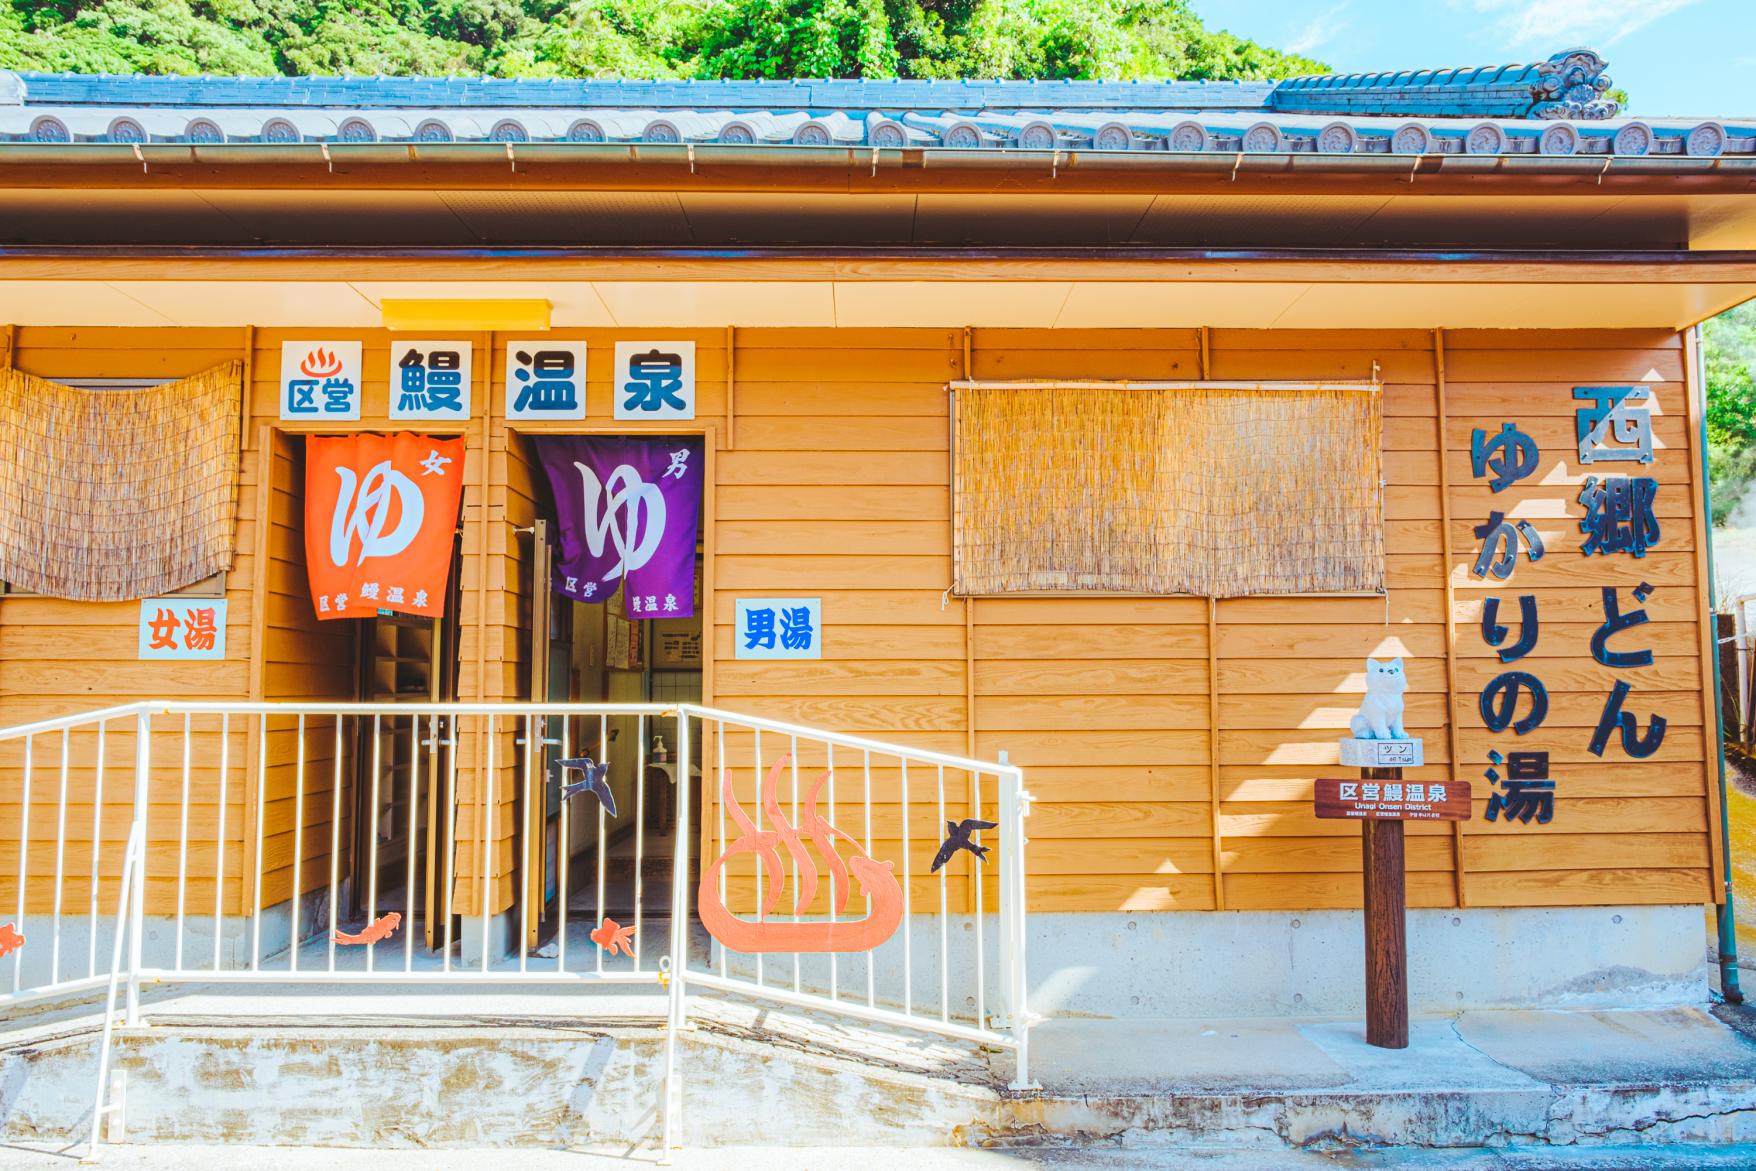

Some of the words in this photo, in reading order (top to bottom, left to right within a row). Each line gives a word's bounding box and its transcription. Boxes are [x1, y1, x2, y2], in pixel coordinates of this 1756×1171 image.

[420, 450, 452, 476] 女
[663, 448, 690, 479] 男
[330, 460, 425, 567] ゆ
[572, 461, 667, 583] ゆ
[1572, 386, 1667, 759] 西郷どん
[148, 607, 217, 651] 女湯
[744, 606, 814, 650] 男湯
[1470, 422, 1556, 825] ゆかりの湯
[1339, 783, 1447, 802] 区営鰻温泉
[1354, 802, 1377, 811] Unagi
[1379, 802, 1403, 811] Onsen
[1404, 803, 1432, 811] District
